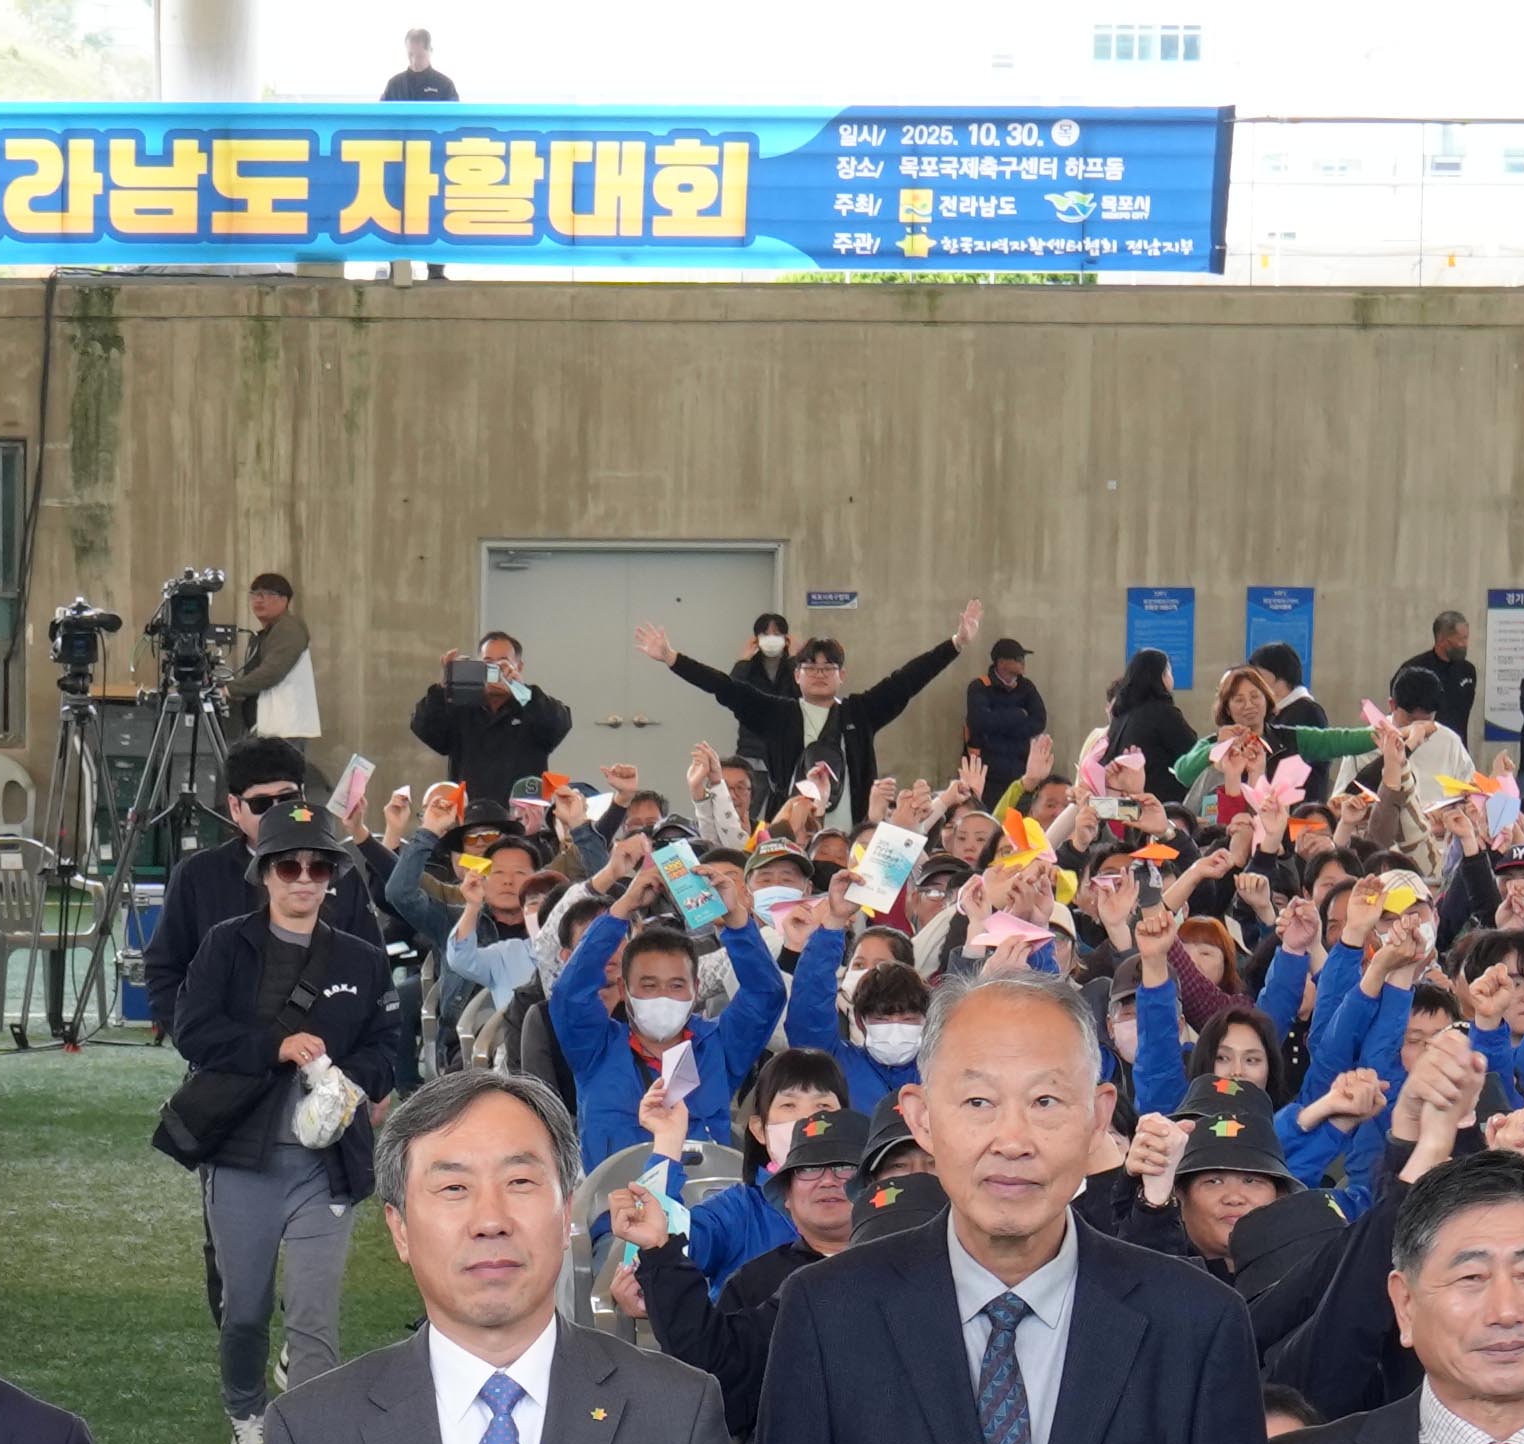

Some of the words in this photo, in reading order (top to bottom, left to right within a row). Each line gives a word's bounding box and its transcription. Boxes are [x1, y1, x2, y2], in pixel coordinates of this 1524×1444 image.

[839, 124, 886, 146] 일시/
[901, 125, 958, 145] 2025.
[969, 123, 1000, 146] 10.
[1006, 123, 1044, 147] 30.
[836, 157, 884, 180] 장소/
[899, 156, 1058, 180] 목포국제축구센터
[1065, 157, 1125, 181] 하프돔
[339, 138, 749, 236] 자활대회
[834, 193, 882, 216] 주최/
[939, 196, 1017, 217] 전라남도
[1101, 195, 1151, 212] 목포시
[833, 232, 880, 255] 주관/
